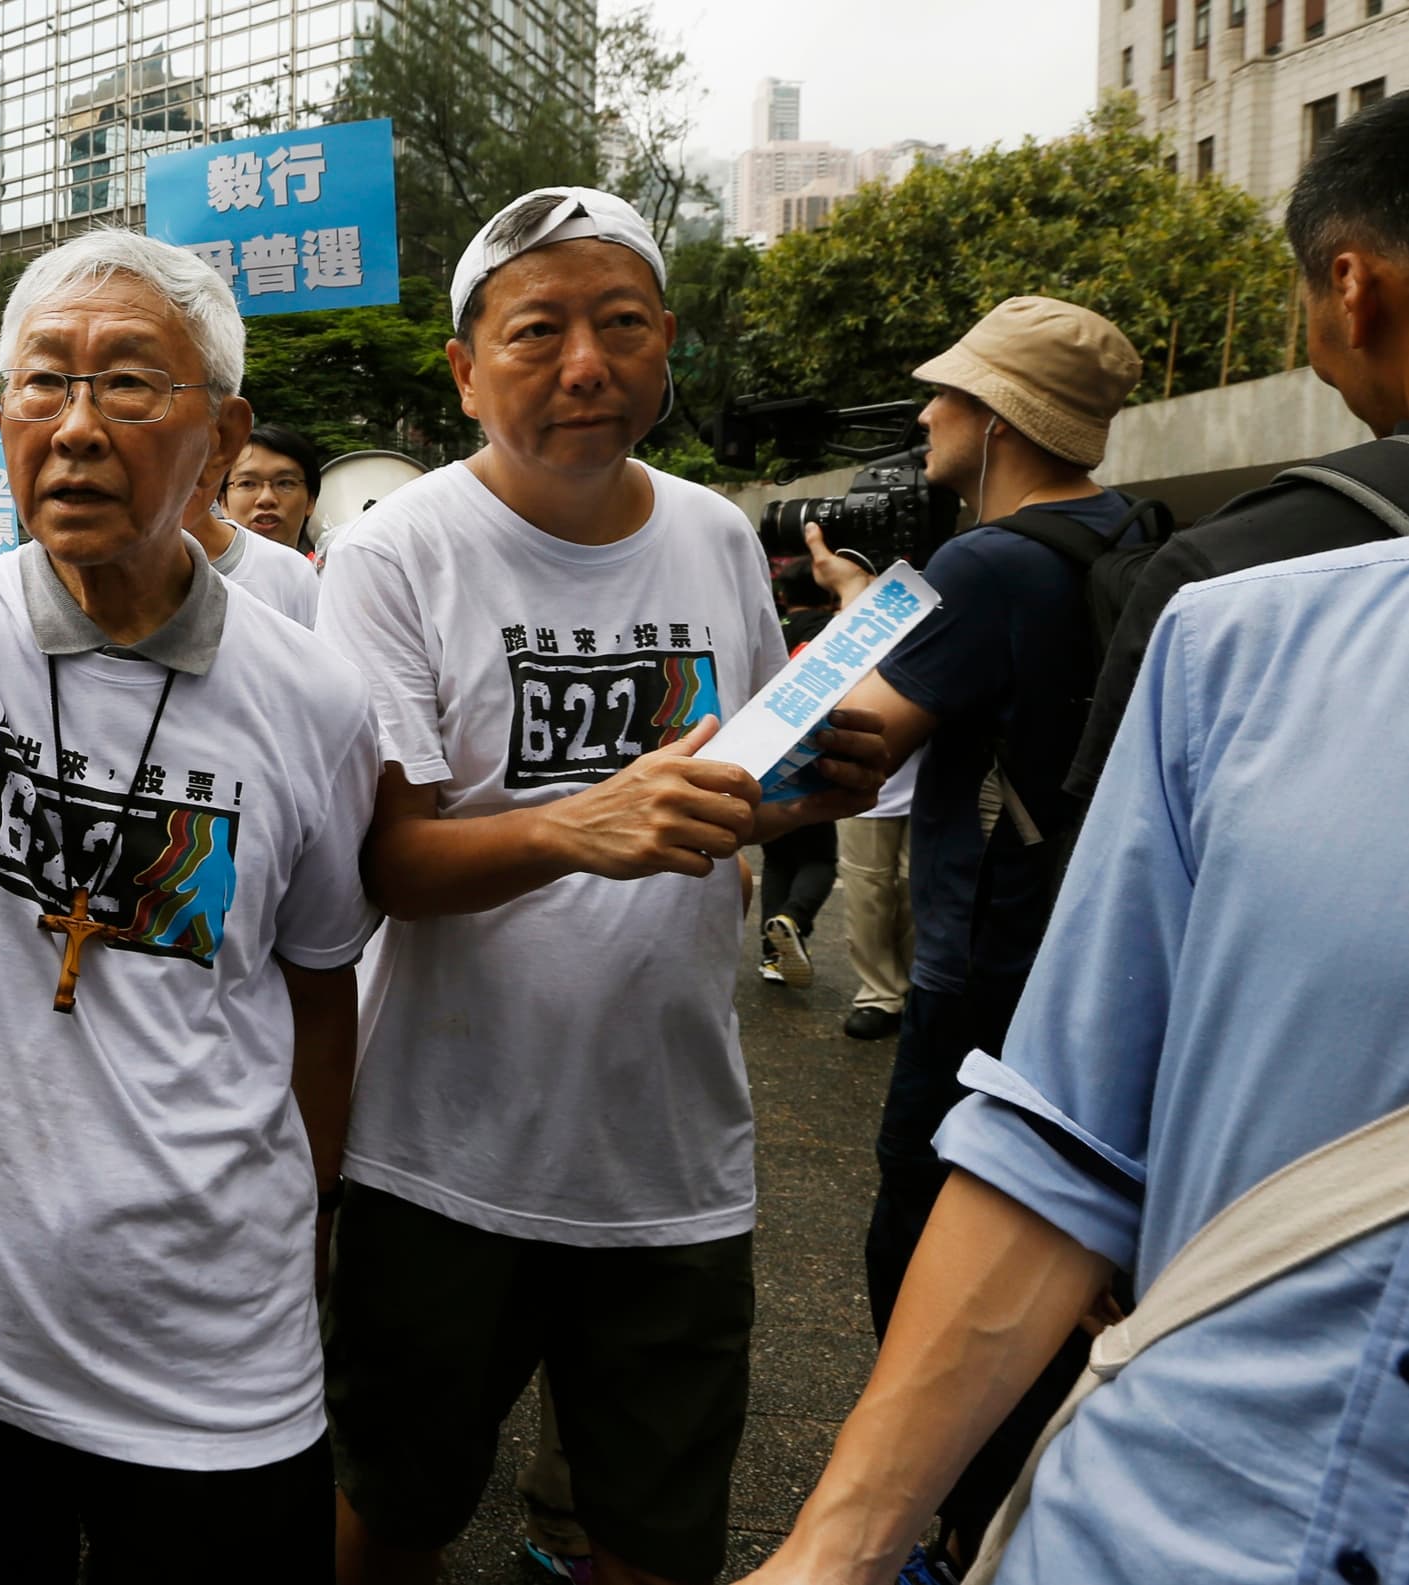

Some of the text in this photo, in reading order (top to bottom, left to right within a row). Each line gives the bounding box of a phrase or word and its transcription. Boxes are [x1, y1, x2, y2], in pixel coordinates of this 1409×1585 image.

[206, 142, 327, 213] 毅行
[16, 734, 244, 807] 出來，投票！
